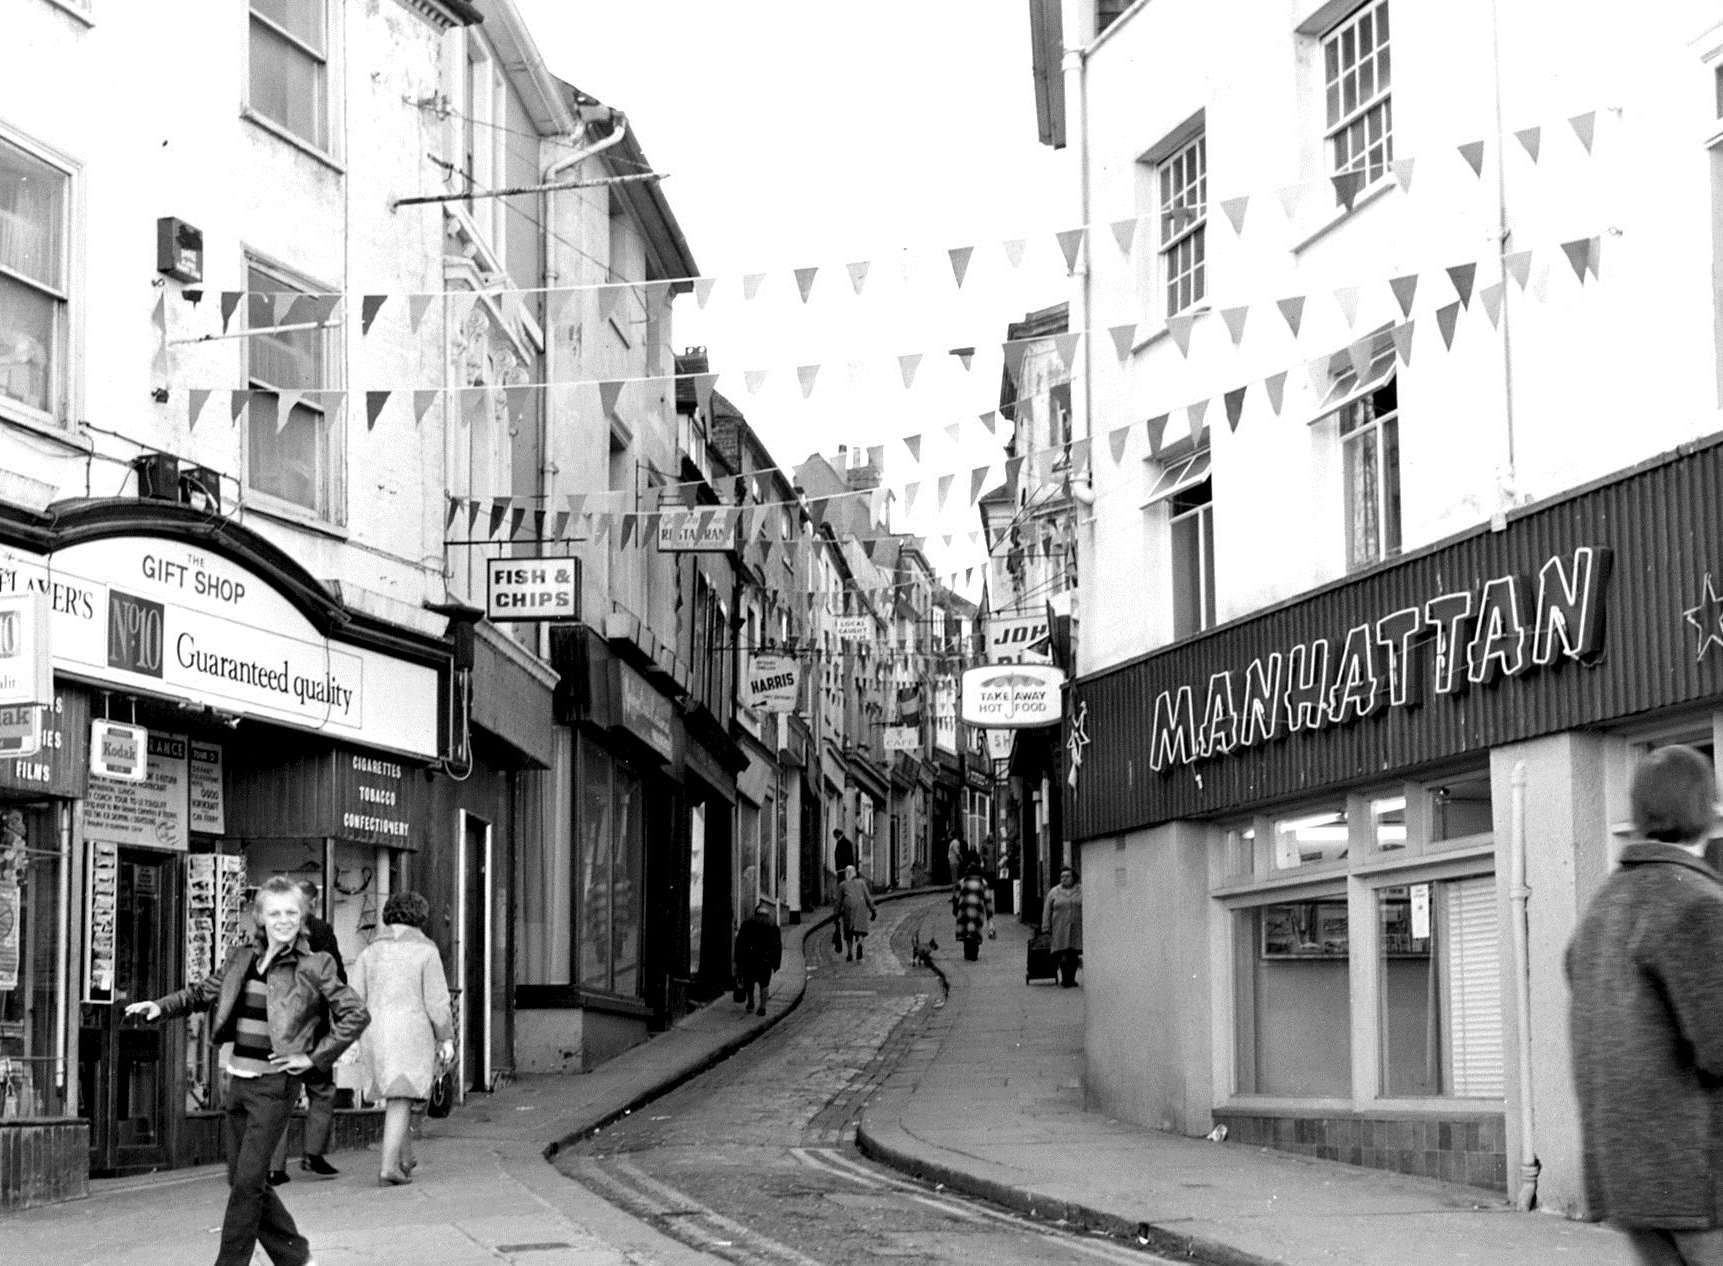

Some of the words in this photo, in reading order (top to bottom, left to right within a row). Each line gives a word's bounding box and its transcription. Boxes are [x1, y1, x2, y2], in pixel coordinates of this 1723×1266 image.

[187, 553, 206, 568] THE
[142, 554, 189, 588] GIFT
[194, 570, 246, 605] SHOP
[494, 569, 547, 585] FISH
[554, 568, 571, 584] &
[495, 591, 570, 608] CHIPS
[1150, 546, 1600, 772] MANHATTAN
[176, 631, 290, 695] Guaranteed
[293, 670, 353, 716] quality
[750, 672, 795, 694] HARRIS
[980, 691, 1009, 701] TAKE
[1014, 691, 1047, 701] AWAY
[979, 703, 1002, 713] HOT
[1014, 702, 1047, 713] FOOD
[103, 741, 137, 761] Kodak
[15, 760, 51, 782] FILMS
[352, 754, 402, 779] CIGARETTES
[359, 785, 397, 806] TOBACCO
[343, 812, 410, 837] CONFECTIONERY
